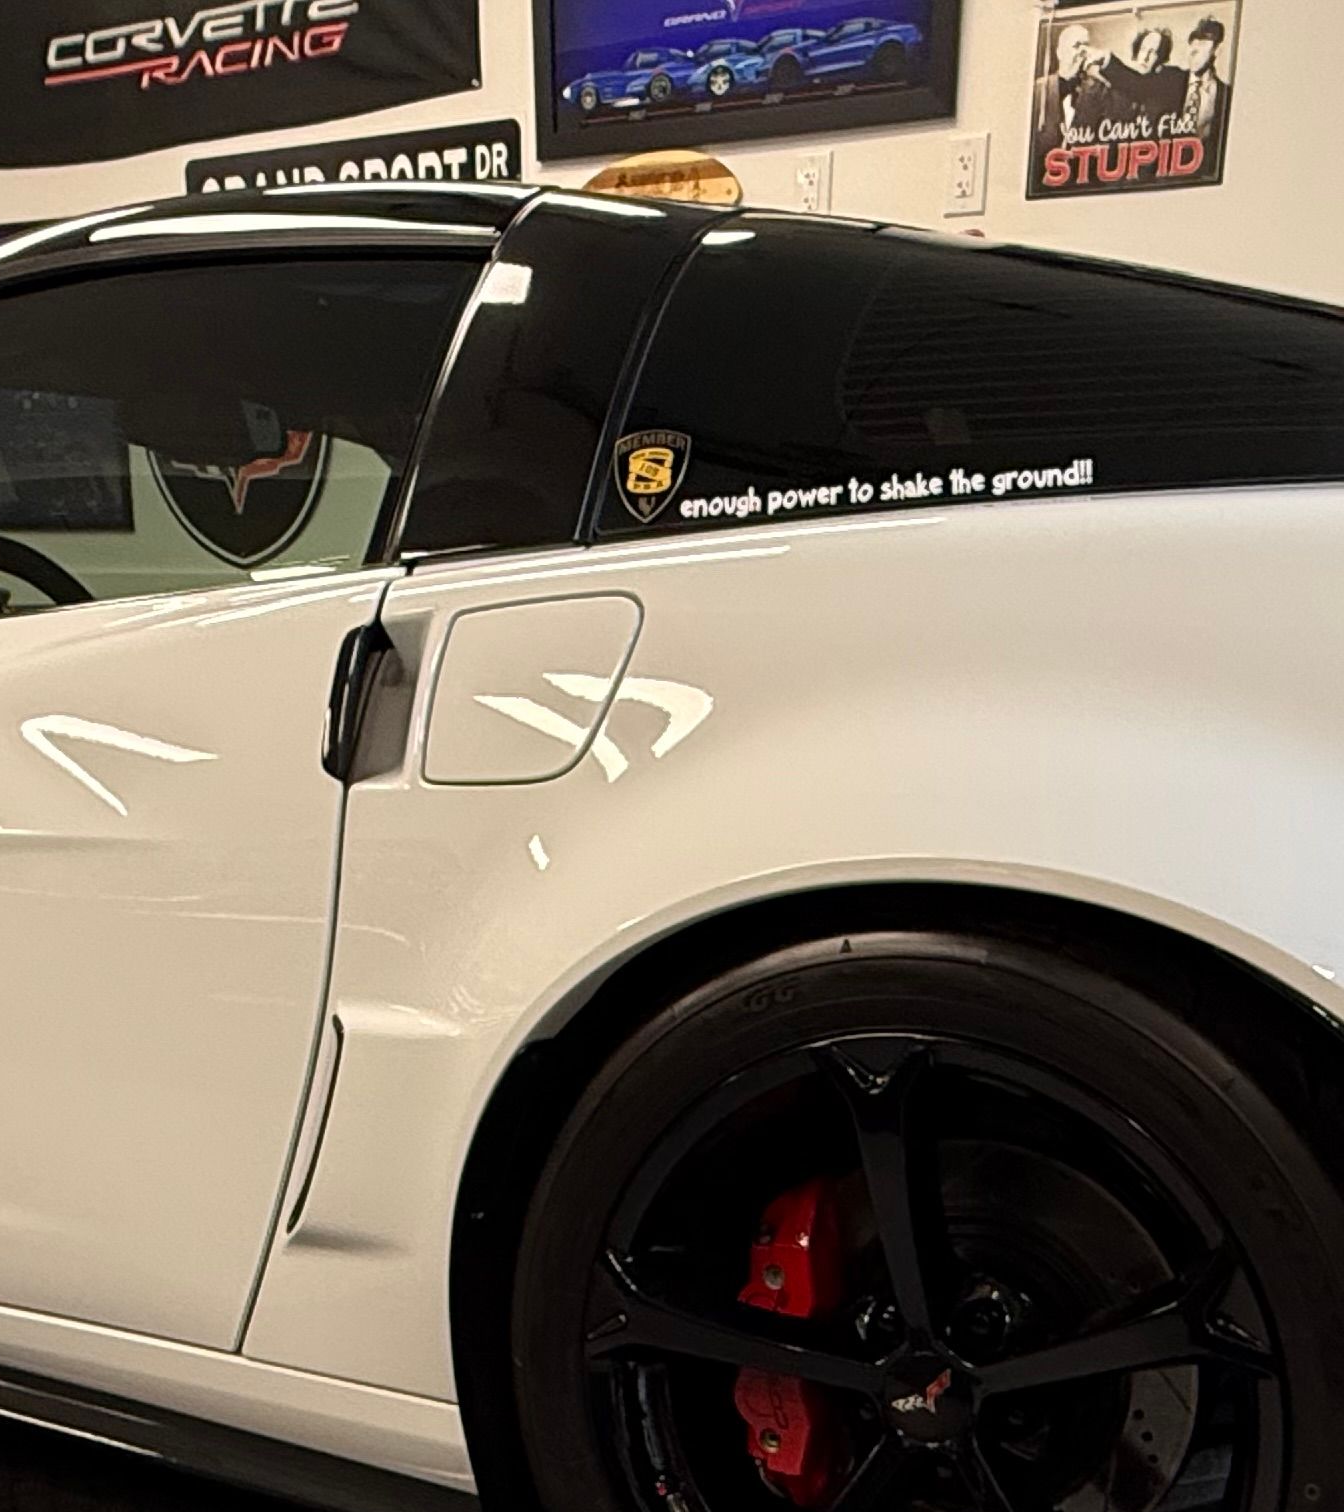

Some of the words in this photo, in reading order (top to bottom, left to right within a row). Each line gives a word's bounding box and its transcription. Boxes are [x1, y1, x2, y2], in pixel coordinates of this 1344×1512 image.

[44, 22, 350, 90] RACING
[46, 0, 359, 69] CORVETTE
[1098, 114, 1153, 142] Can't
[475, 142, 509, 179] DR
[1042, 137, 1204, 187] STUPID
[680, 486, 761, 519] enough
[767, 485, 844, 516] power
[848, 477, 874, 504] to
[879, 472, 944, 501] shake
[949, 467, 986, 495] the
[992, 458, 1094, 496] ground!!
